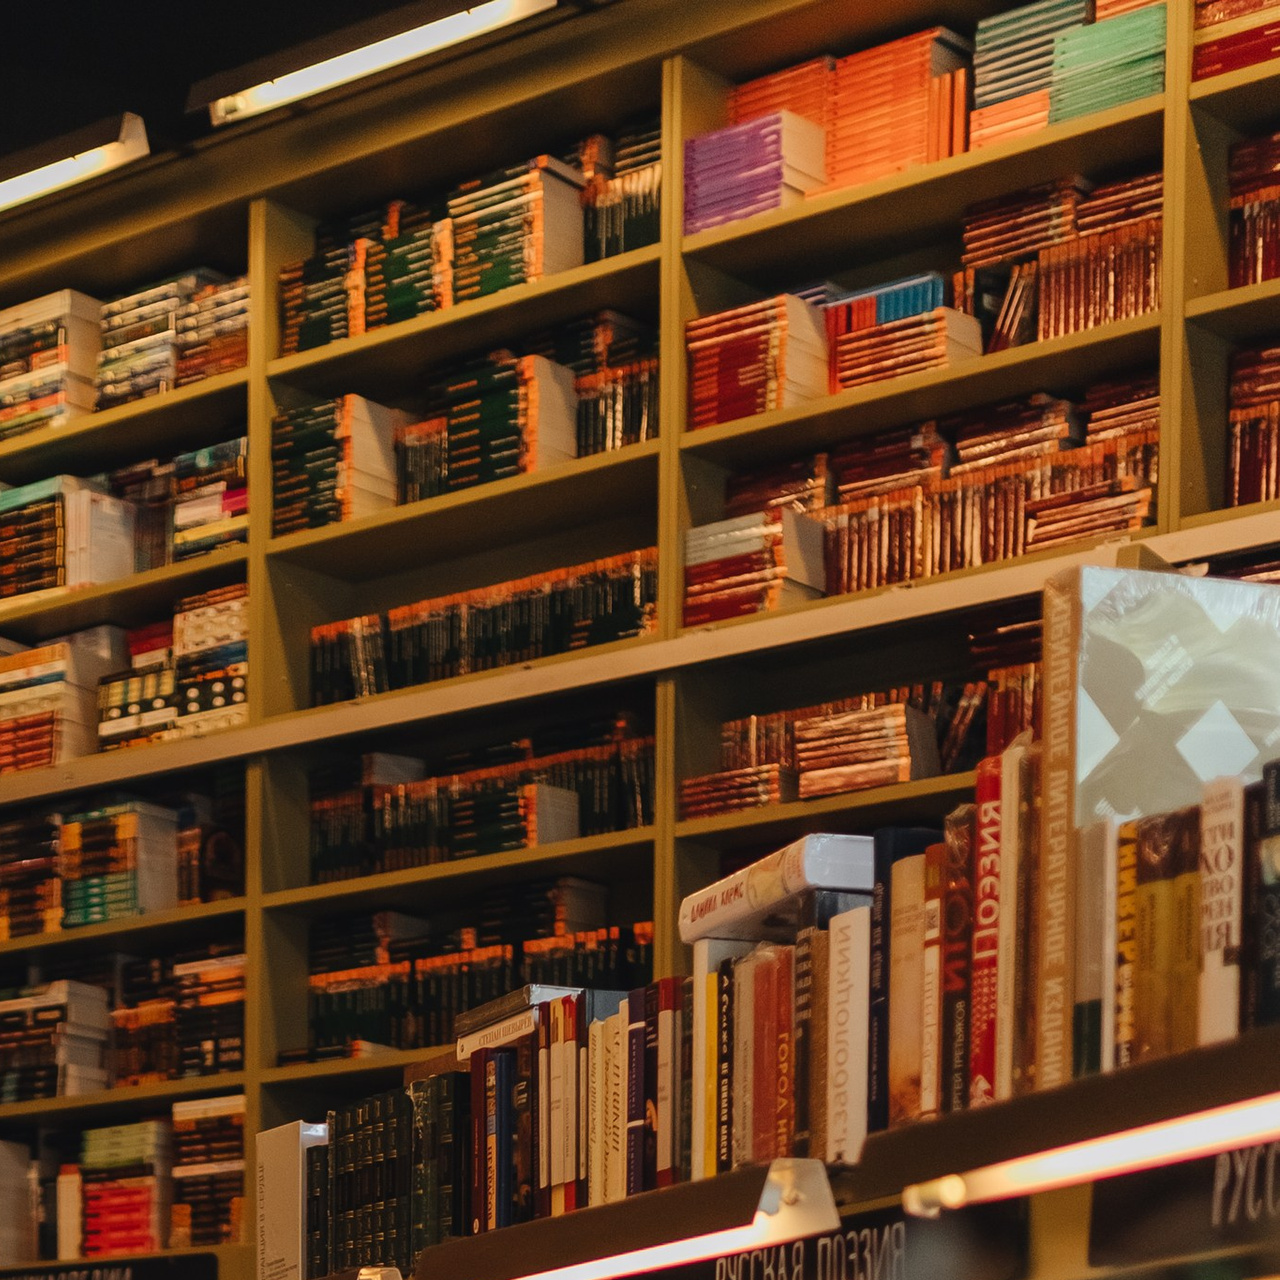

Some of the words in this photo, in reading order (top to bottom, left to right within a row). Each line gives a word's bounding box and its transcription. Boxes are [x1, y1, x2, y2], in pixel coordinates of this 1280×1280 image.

[974, 800, 1002, 960] ПОЭЗИЯ
[1045, 770, 1068, 969] ЛИТЕРАТУРНОЕ
[478, 1030, 502, 1046] СТЕПАН
[777, 1032, 789, 1114] ГОРОД
[953, 1000, 966, 1069] ТРЕТЬЯКОВ
[1042, 977, 1064, 1089] ИЗДАНИ
[953, 1071, 965, 1114] ЕРГЕЙ
[258, 1161, 266, 1210] СЕРДЦЕ
[1211, 1138, 1280, 1228] РУСС
